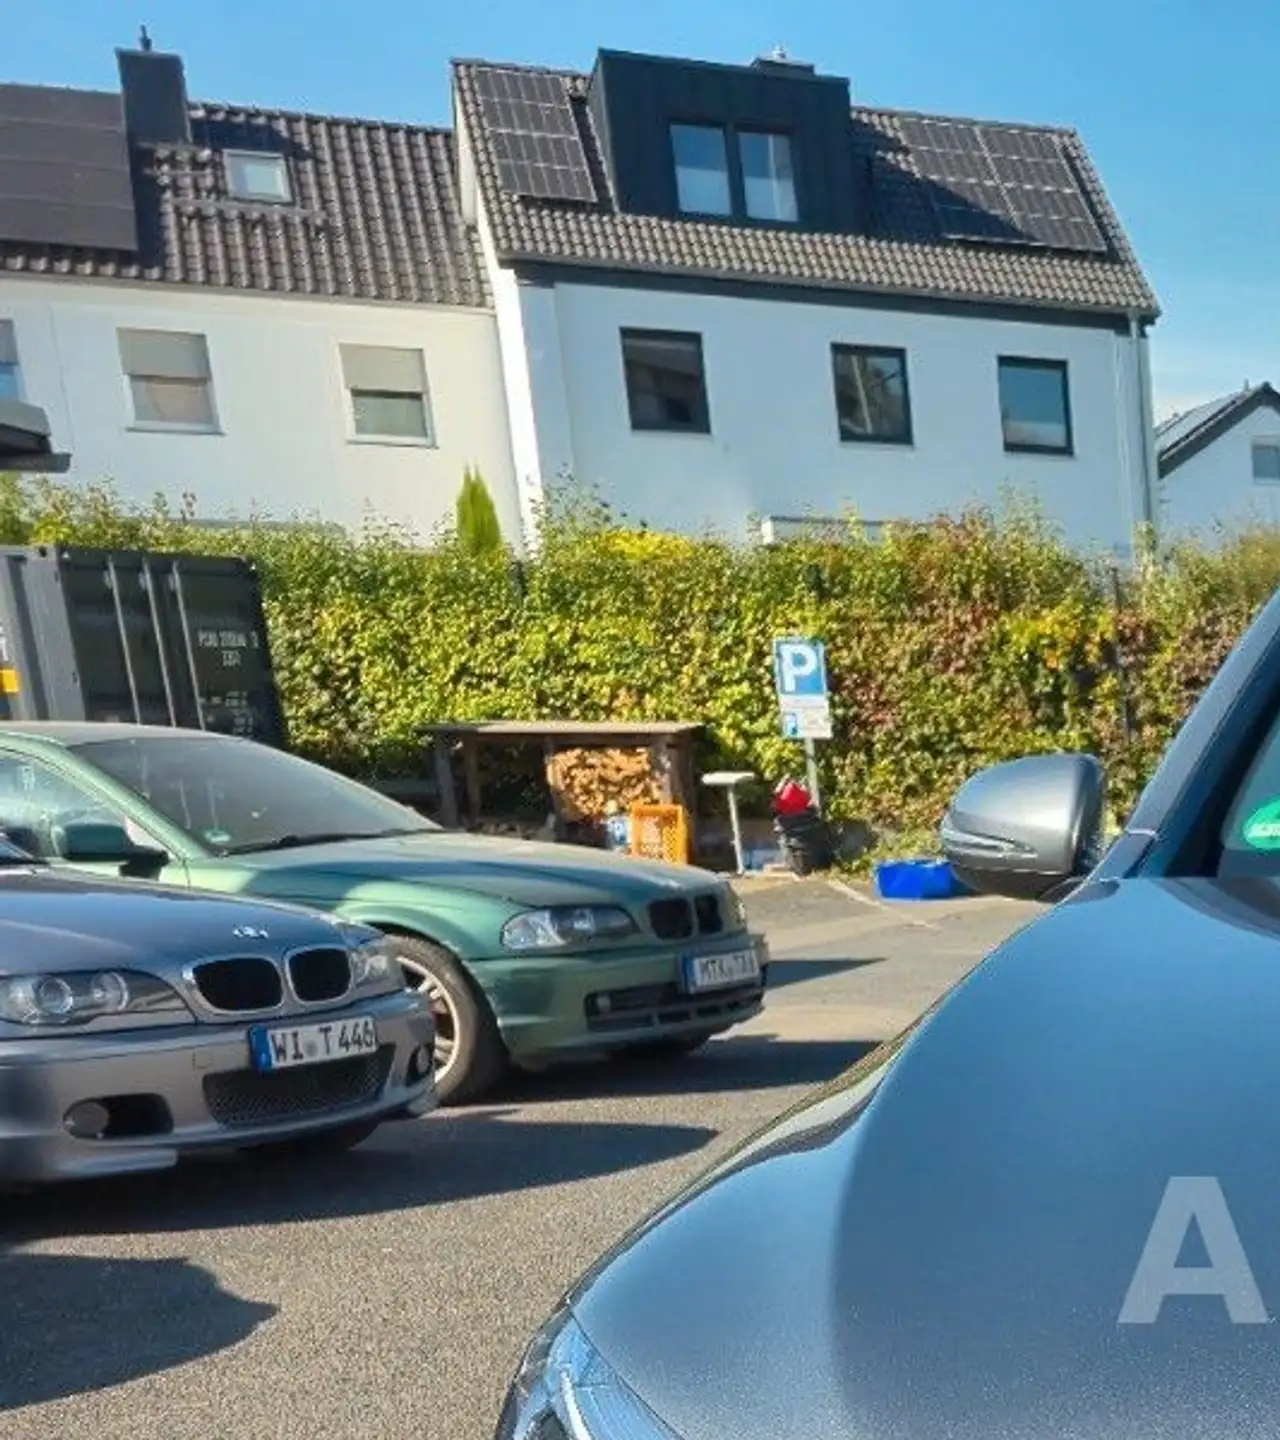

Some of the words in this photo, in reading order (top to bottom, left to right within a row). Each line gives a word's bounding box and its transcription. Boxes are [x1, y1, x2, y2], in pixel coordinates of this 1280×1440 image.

[780, 643, 818, 693] P
[271, 1030, 303, 1062] WI
[318, 1025, 333, 1056] T
